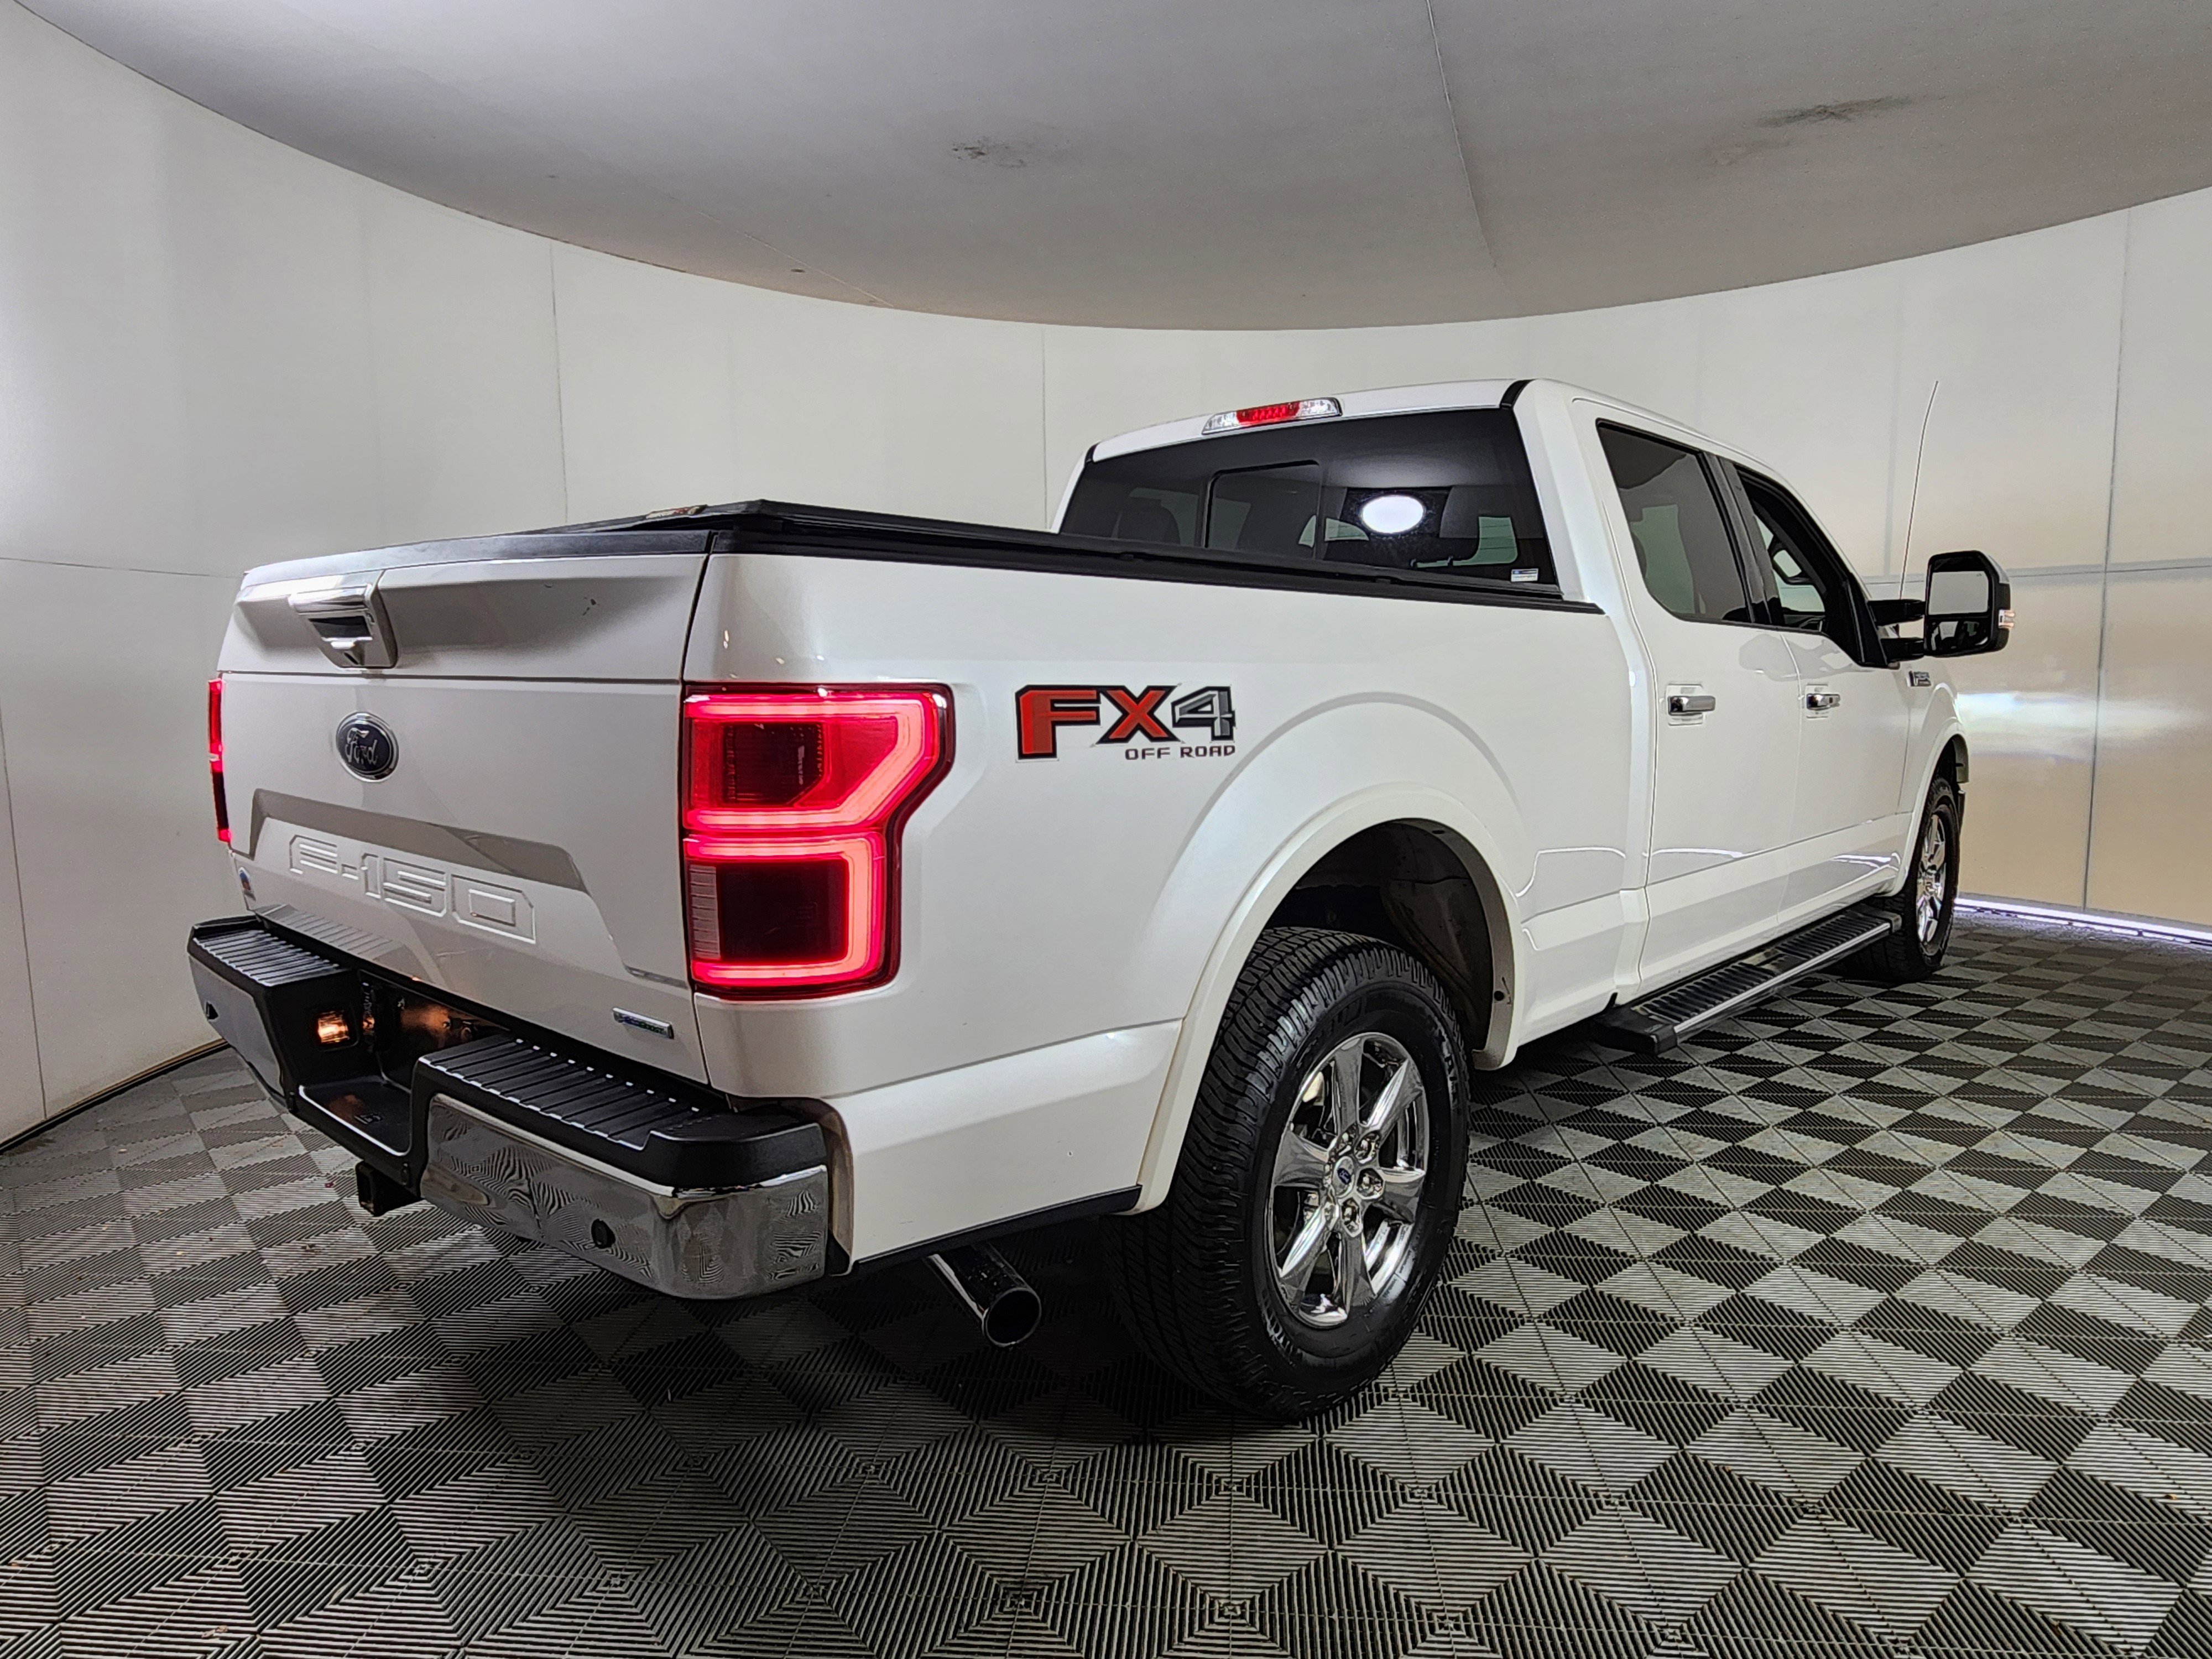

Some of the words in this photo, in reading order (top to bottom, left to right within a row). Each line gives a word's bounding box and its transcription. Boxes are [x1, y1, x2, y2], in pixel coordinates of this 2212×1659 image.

[344, 727, 378, 765] Ford
[1015, 684, 1236, 759] FX4
[1124, 747, 1171, 760] OFF
[1180, 744, 1236, 759] ROAD
[289, 834, 536, 944] F-150
